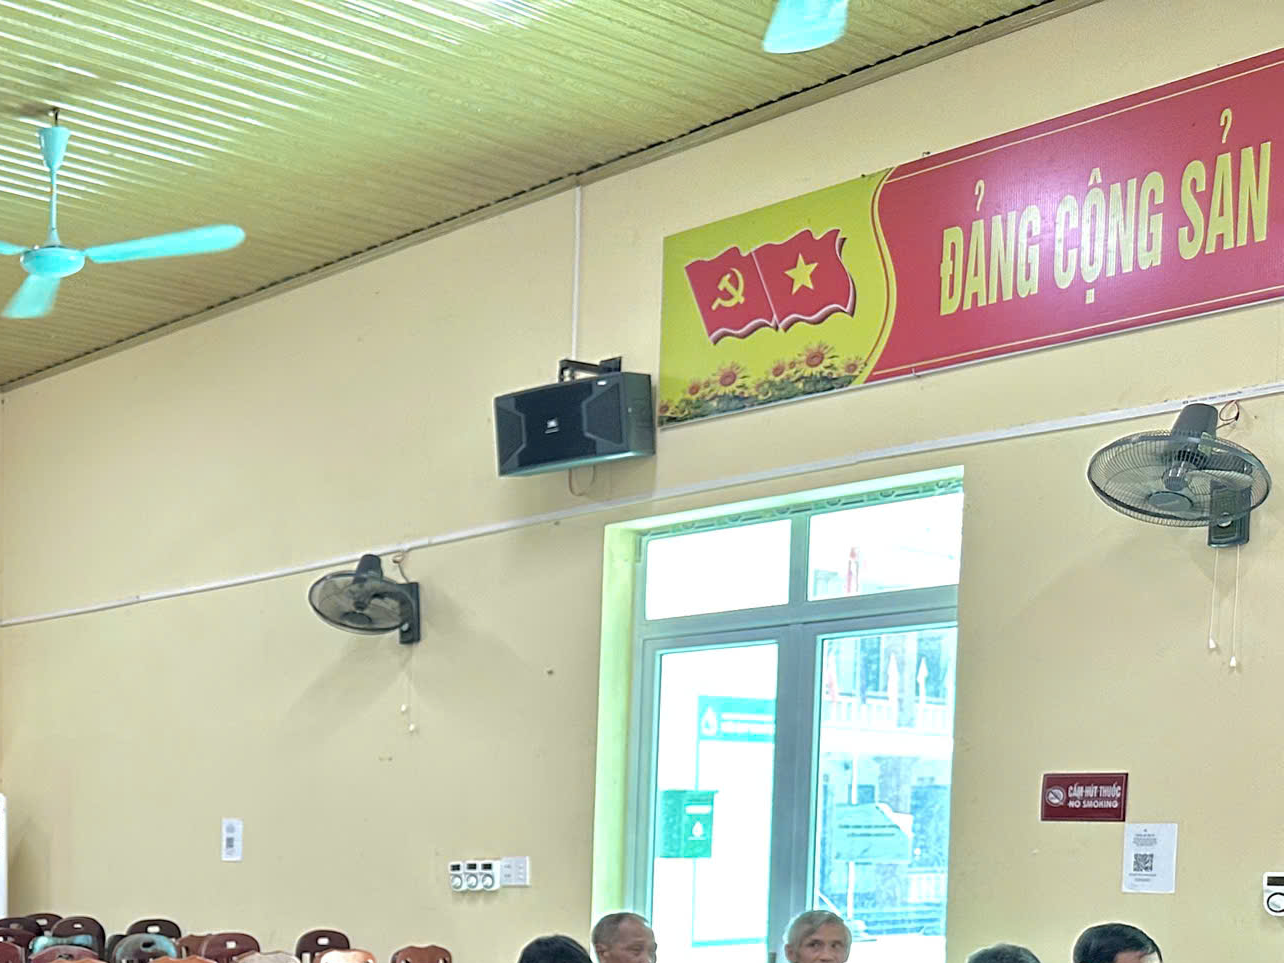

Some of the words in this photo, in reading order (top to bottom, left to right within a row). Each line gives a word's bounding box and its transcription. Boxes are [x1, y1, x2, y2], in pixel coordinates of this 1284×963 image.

[939, 179, 1041, 316] ĐẢNG
[1052, 168, 1165, 304] CỘNG
[1178, 108, 1272, 261] SẢN
[1084, 783, 1098, 798] HÚT
[1099, 782, 1121, 798] THUỐC
[1068, 800, 1081, 808] NO
[1082, 800, 1118, 808] SMOKING
